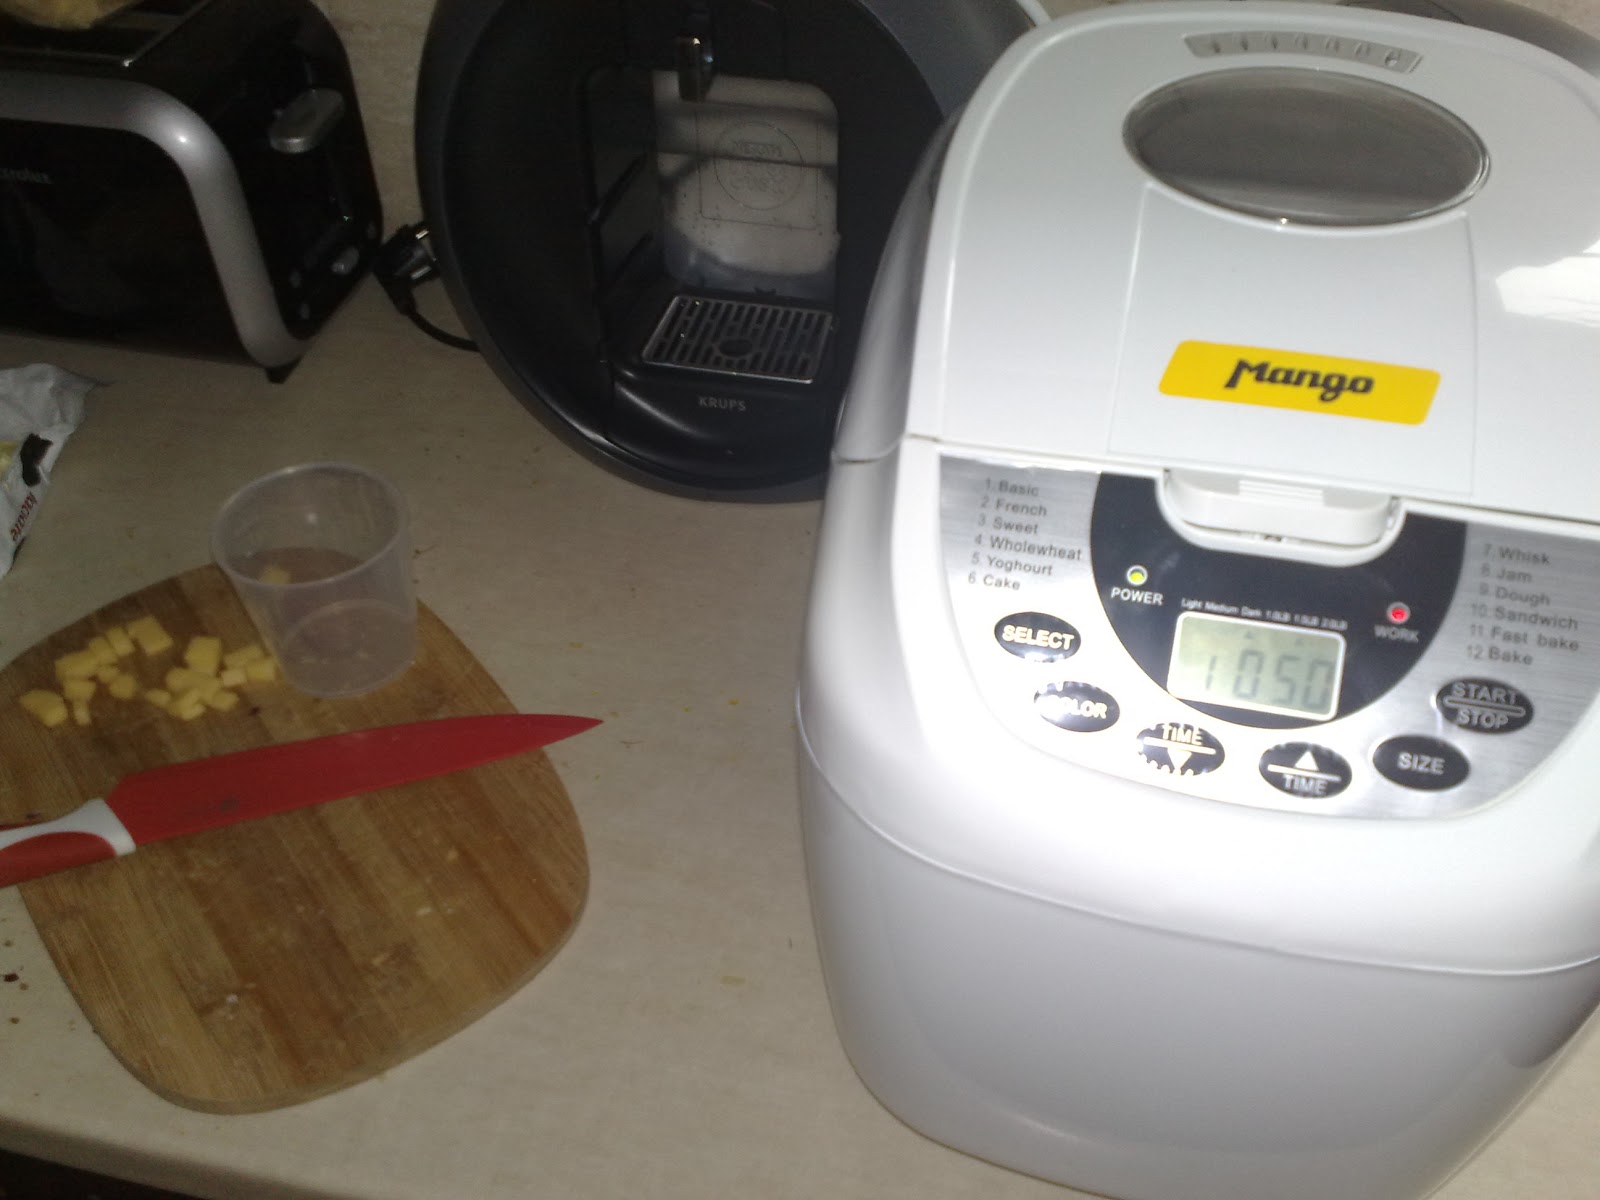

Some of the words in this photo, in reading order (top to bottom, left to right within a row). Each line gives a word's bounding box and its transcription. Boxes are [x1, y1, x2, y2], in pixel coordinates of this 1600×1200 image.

[1224, 358, 1375, 403] Mango
[698, 396, 747, 412] KRUPS
[998, 480, 1040, 497] Basic
[995, 498, 1048, 517] French
[992, 516, 1039, 534] Sweet
[990, 535, 1083, 561] Wholewheat
[1498, 546, 1551, 565] Whisk
[987, 554, 1054, 576] Yoghourt
[1497, 567, 1533, 583] Jam
[983, 574, 1021, 591] Cake
[1111, 587, 1164, 606] POWER
[1181, 597, 1203, 610] Light
[1204, 600, 1239, 615] Medium
[1495, 586, 1552, 608] Dough
[1494, 605, 1579, 631] Sandwich
[1002, 624, 1075, 650] SELECT
[1374, 624, 1420, 644] WORK
[1490, 625, 1529, 645] Fast
[1537, 632, 1580, 652] bake
[1488, 645, 1534, 666] Bake
[1452, 680, 1517, 706] START
[1455, 707, 1509, 729] STOP
[1163, 724, 1204, 746] TIME
[1398, 752, 1446, 775] SIZE
[1283, 774, 1328, 796] TIME
